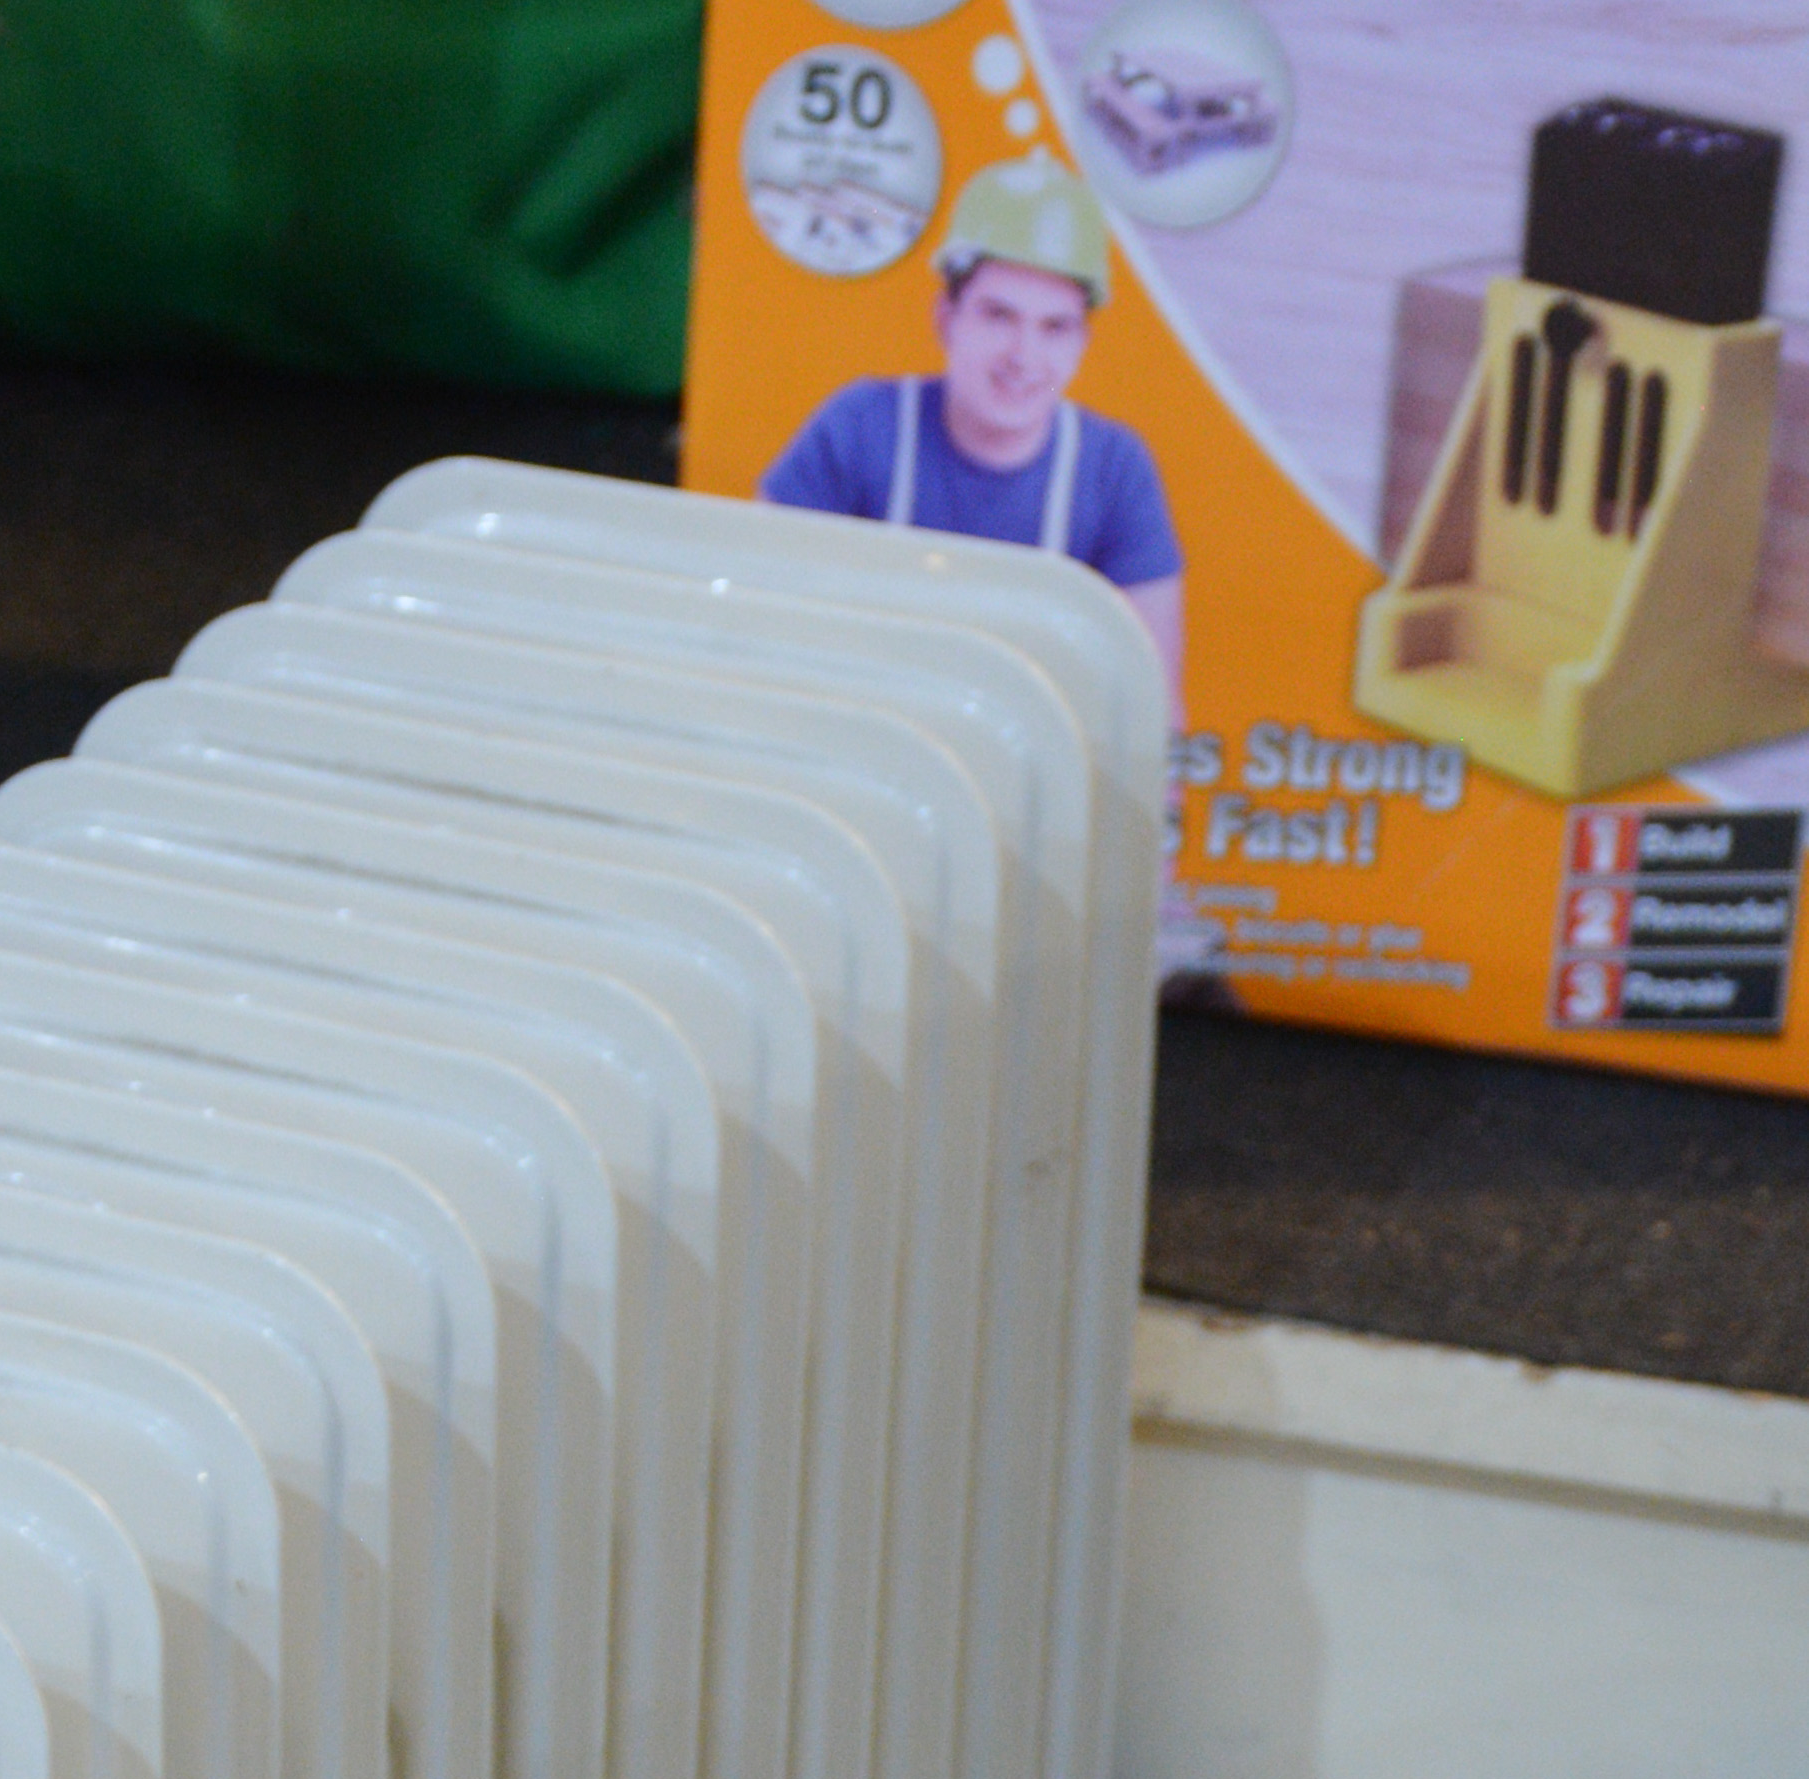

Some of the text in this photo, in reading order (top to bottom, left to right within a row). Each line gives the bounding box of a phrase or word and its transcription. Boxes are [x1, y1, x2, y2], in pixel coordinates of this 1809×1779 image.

[798, 61, 893, 130] 50
[1243, 718, 1464, 811] Strong
[1205, 792, 1380, 864] Fast!
[1591, 814, 1732, 873] 1 Build
[1573, 886, 1615, 946] 2
[1565, 960, 1738, 1021] 3 Repair
